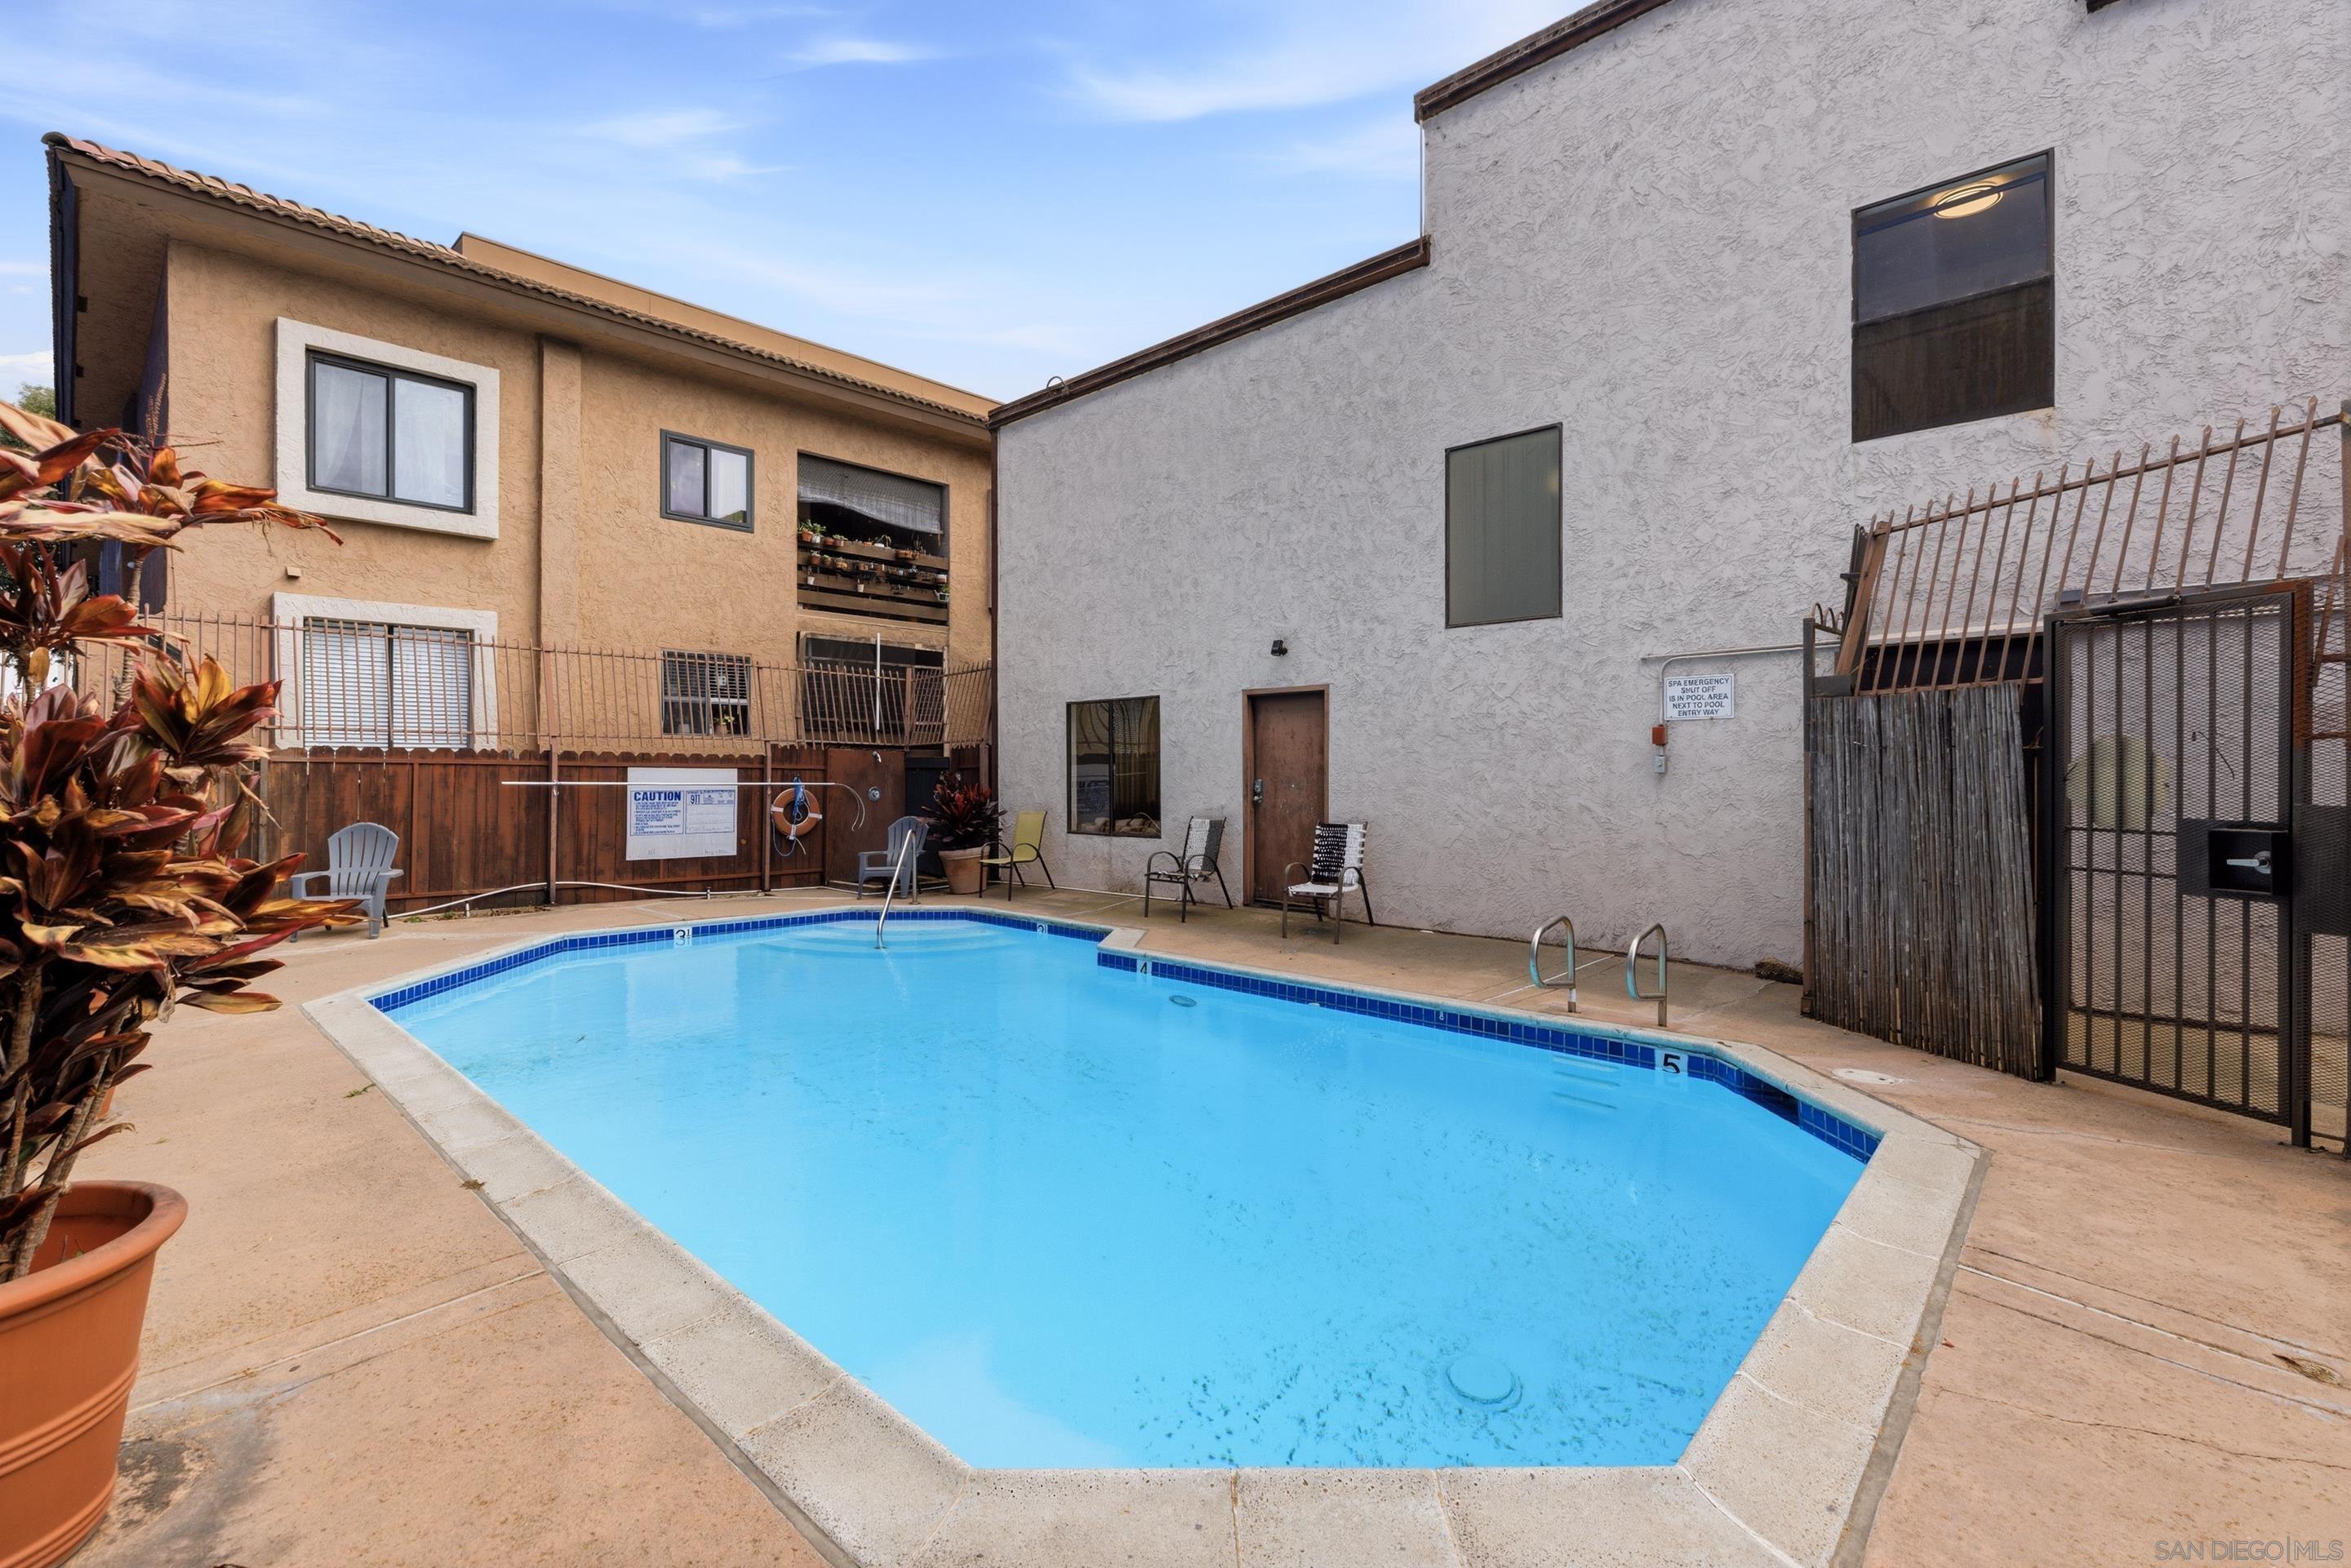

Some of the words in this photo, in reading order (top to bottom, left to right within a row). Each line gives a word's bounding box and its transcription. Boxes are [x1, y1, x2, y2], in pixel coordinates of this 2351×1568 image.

[1683, 677, 1730, 686] EMERGENCY
[633, 791, 682, 802] CAUTION
[690, 794, 700, 804] 911
[1140, 961, 1148, 974] 4
[1662, 1053, 1681, 1074] 5
